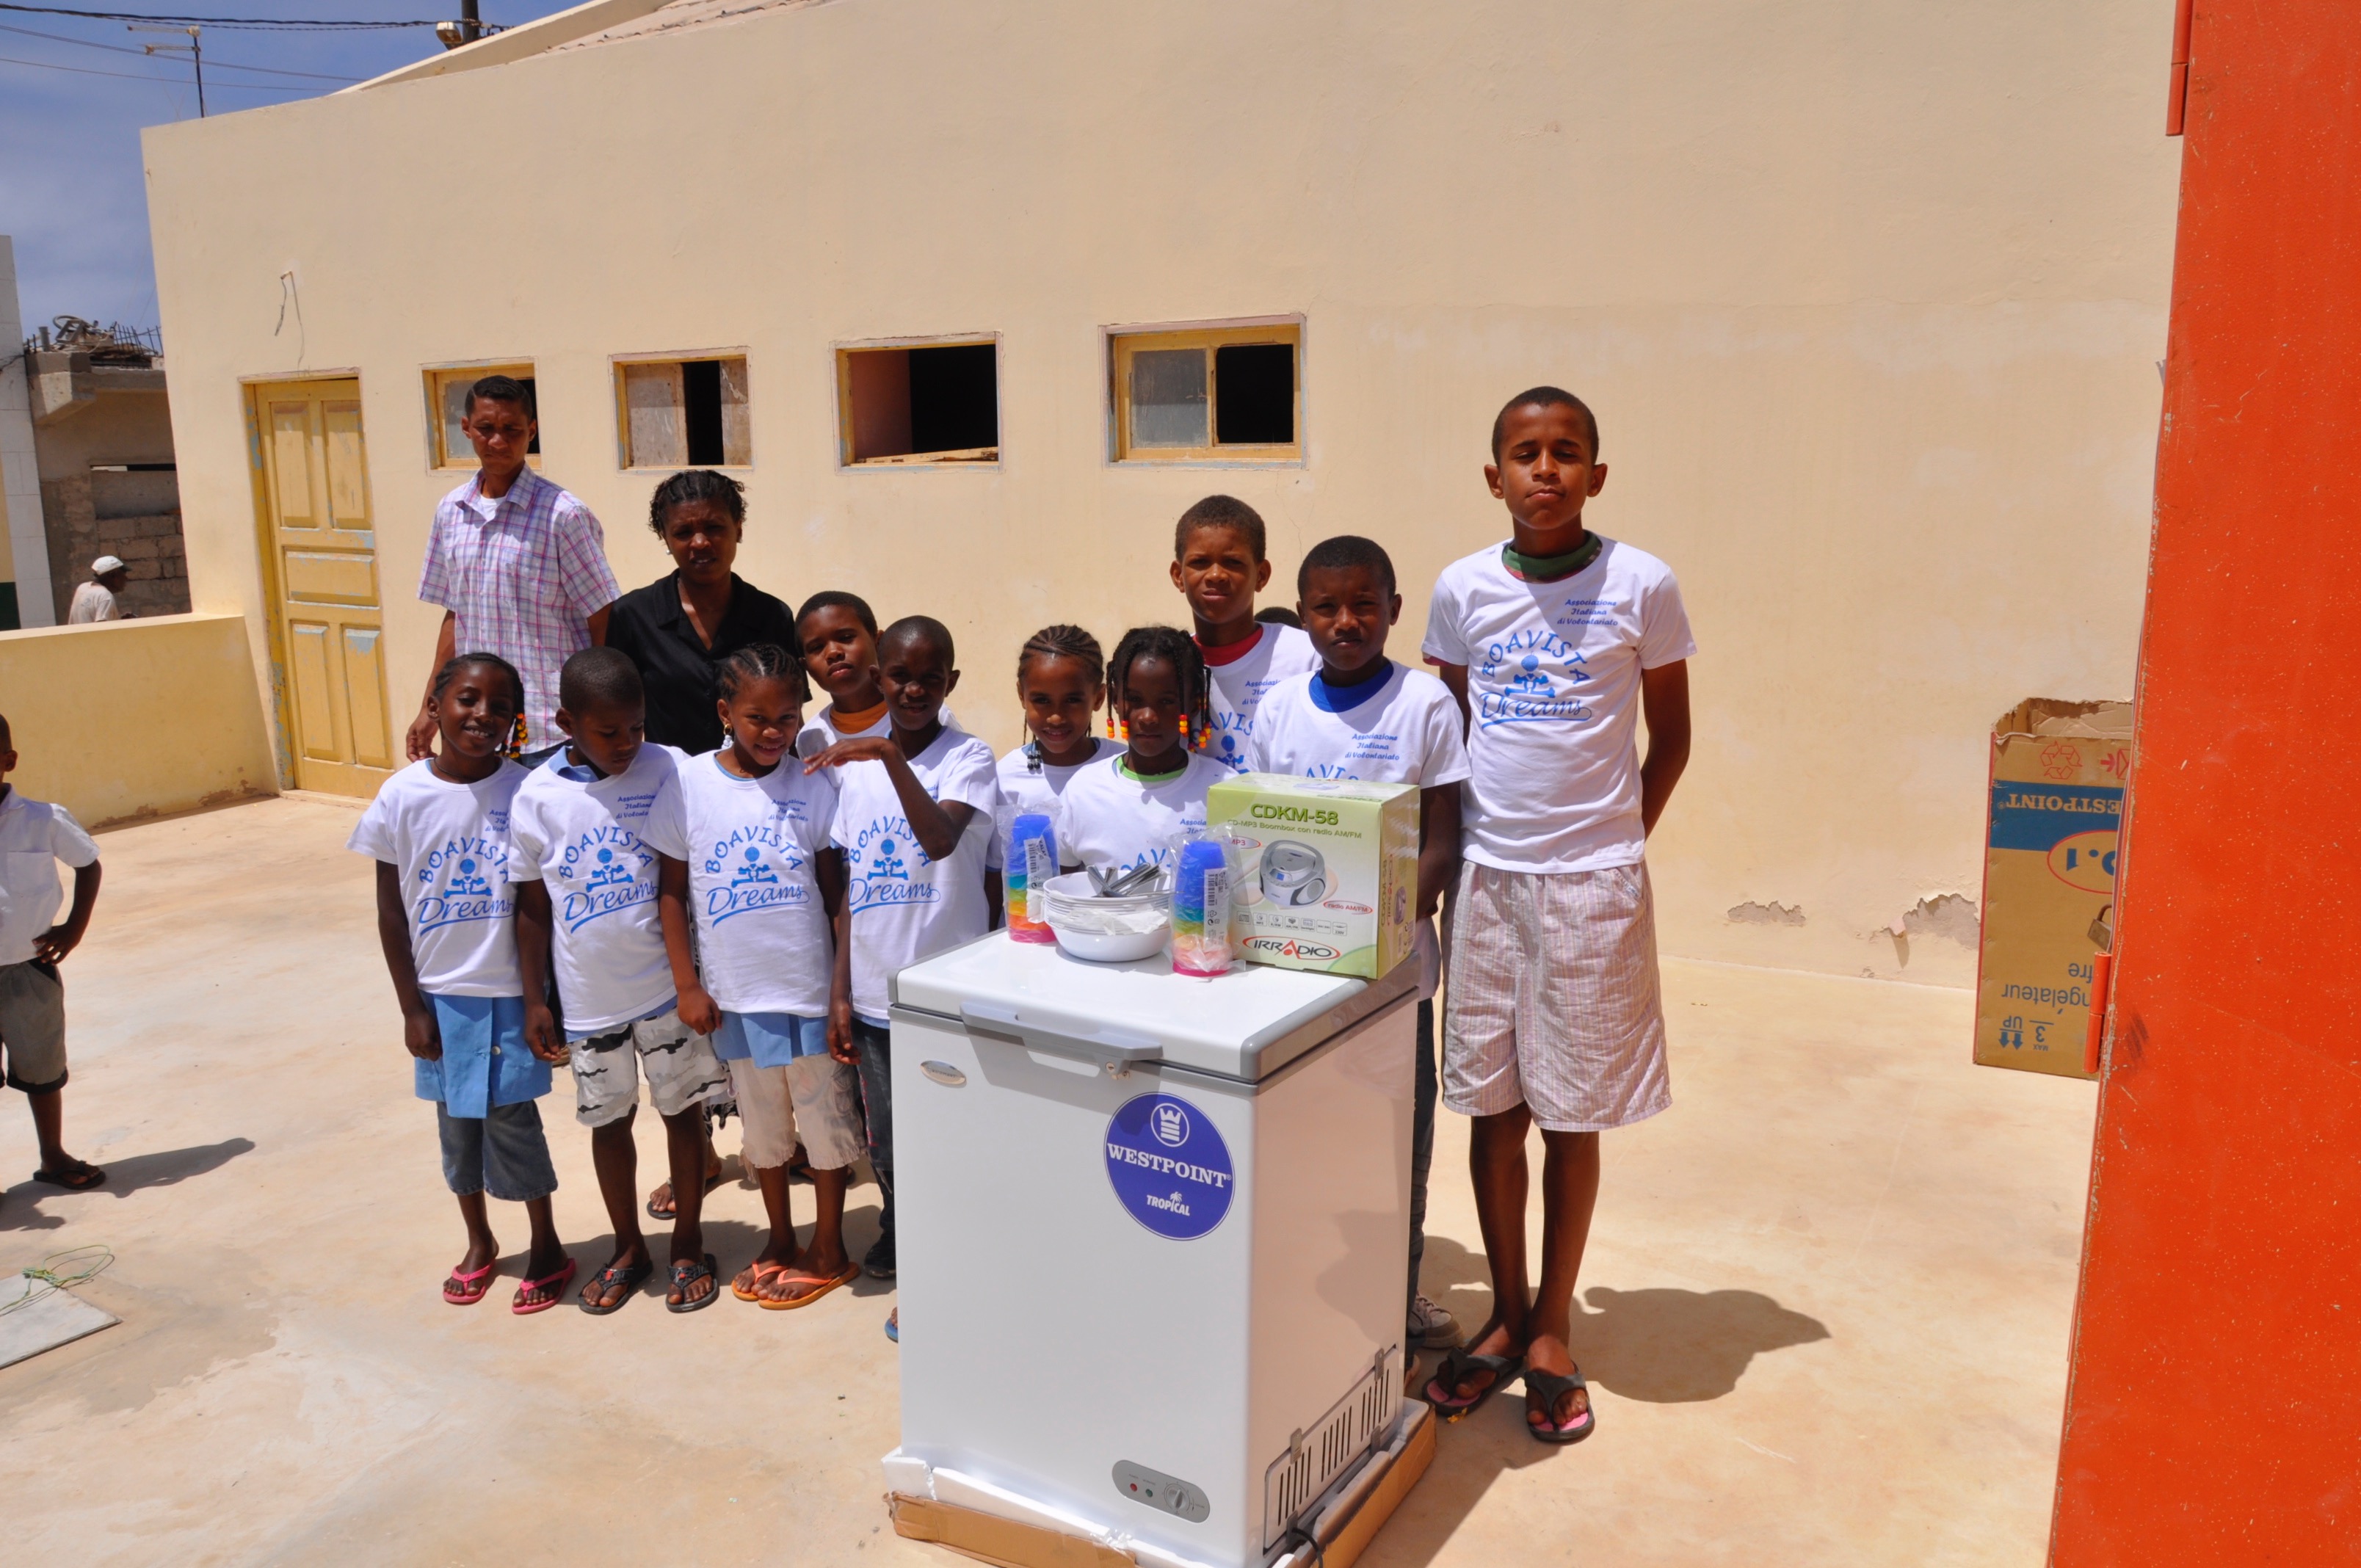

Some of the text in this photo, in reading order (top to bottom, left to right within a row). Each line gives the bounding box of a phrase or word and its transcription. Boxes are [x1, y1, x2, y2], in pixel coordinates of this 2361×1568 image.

[1564, 598, 1617, 606] Associazione
[1570, 608, 1607, 616] Italiana
[1567, 618, 1619, 626] Volontariato
[1481, 629, 1591, 685] BOAVISTA
[1479, 691, 1590, 721] Dreams
[1352, 733, 1398, 741] Associazione
[1356, 742, 1390, 750] Italiana
[1353, 752, 1400, 761] Volontariato
[1180, 818, 1208, 826] Associa
[1250, 803, 1338, 826] CDKM-58
[1259, 822, 1295, 832] Boombox
[1334, 830, 1362, 839] AM/FM
[558, 826, 654, 879] BOAVISTA
[705, 825, 804, 874] BOAVISTA
[849, 877, 938, 906] Dreams
[417, 896, 514, 924] Dreams
[562, 881, 659, 922] Dreams
[705, 885, 809, 918] Dreams
[1254, 939, 1332, 959] IRRADIO
[2003, 1015, 2023, 1030] UP
[2034, 1025, 2046, 1043] 3
[2033, 1043, 2050, 1052] MAX
[1146, 1192, 1191, 1216] TROPICAL
